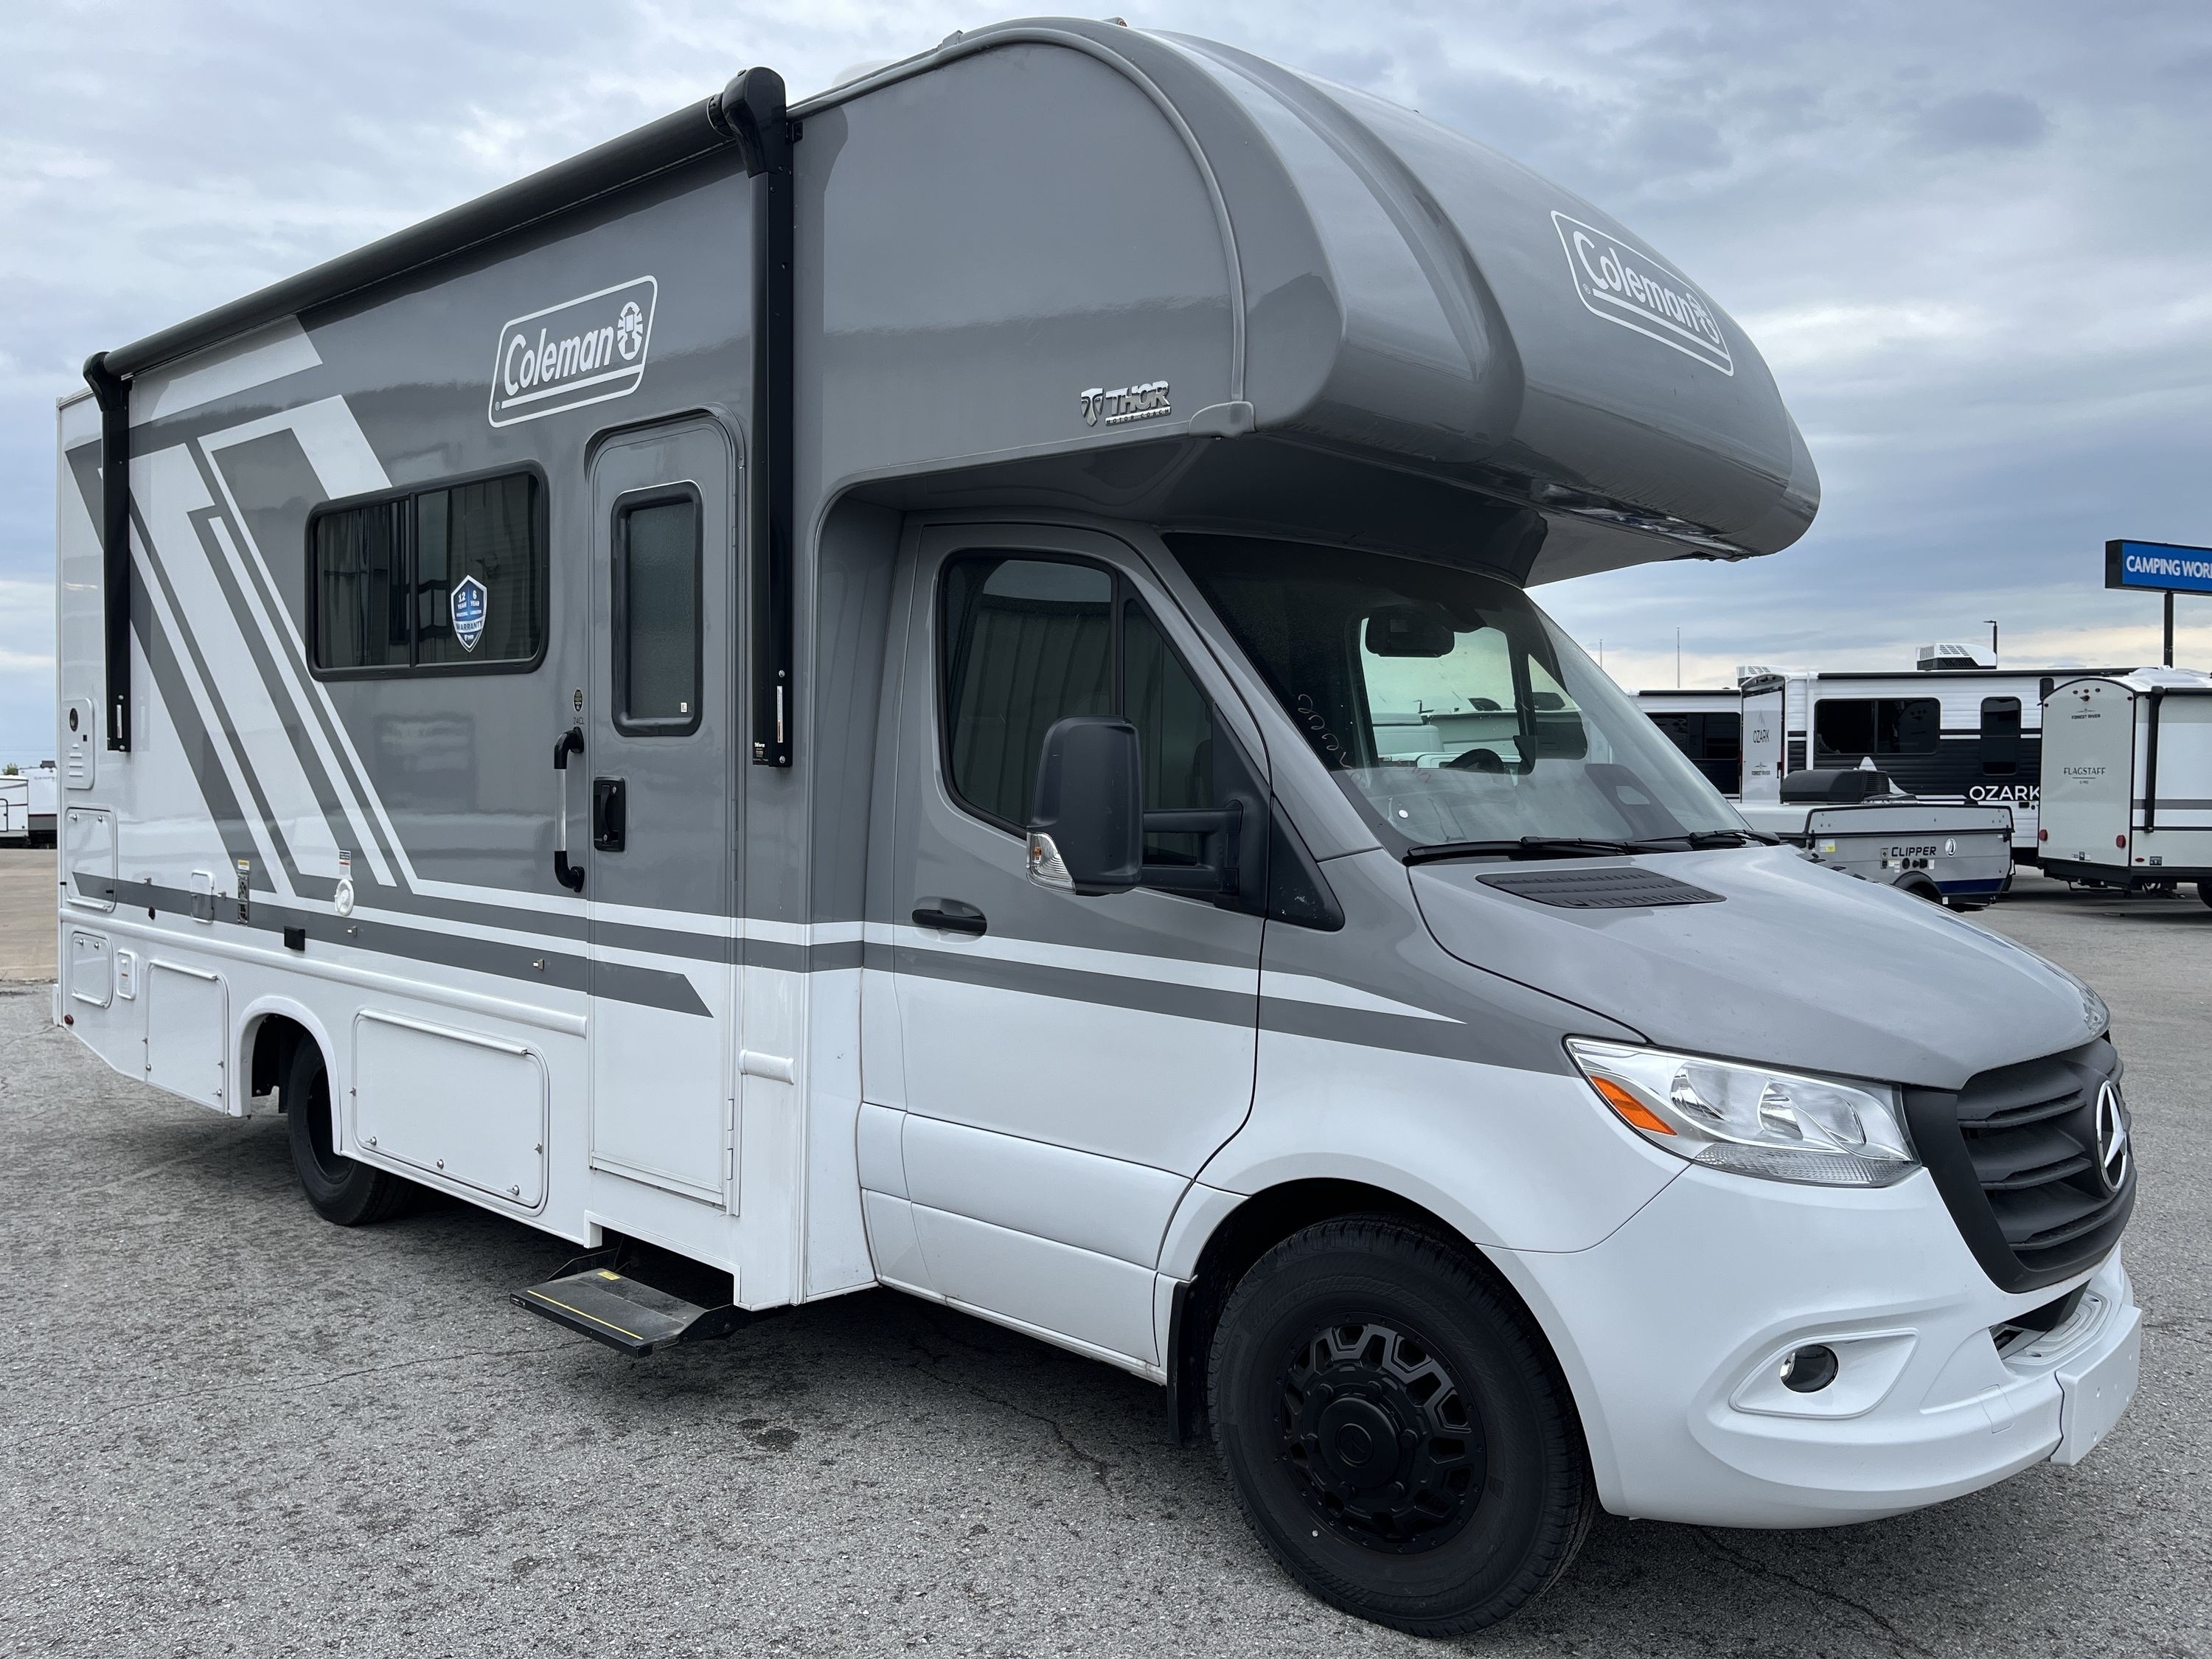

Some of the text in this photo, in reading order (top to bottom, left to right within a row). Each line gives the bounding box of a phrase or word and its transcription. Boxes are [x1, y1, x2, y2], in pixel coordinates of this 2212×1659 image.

[1573, 231, 1700, 333] Coleman
[504, 326, 615, 397] Coleman
[1105, 380, 1171, 415] THOR
[1106, 408, 1169, 425] MOTOR COACH
[2126, 555, 2181, 576] CAMPING
[458, 590, 477, 602] 12 6
[456, 621, 483, 631] WARRANTY
[1753, 729, 1770, 743] OZARK
[2063, 767, 2106, 775] FLAGSTAFF
[1969, 785, 2040, 801] OZARK
[1891, 846, 1936, 857] CLIPPER
